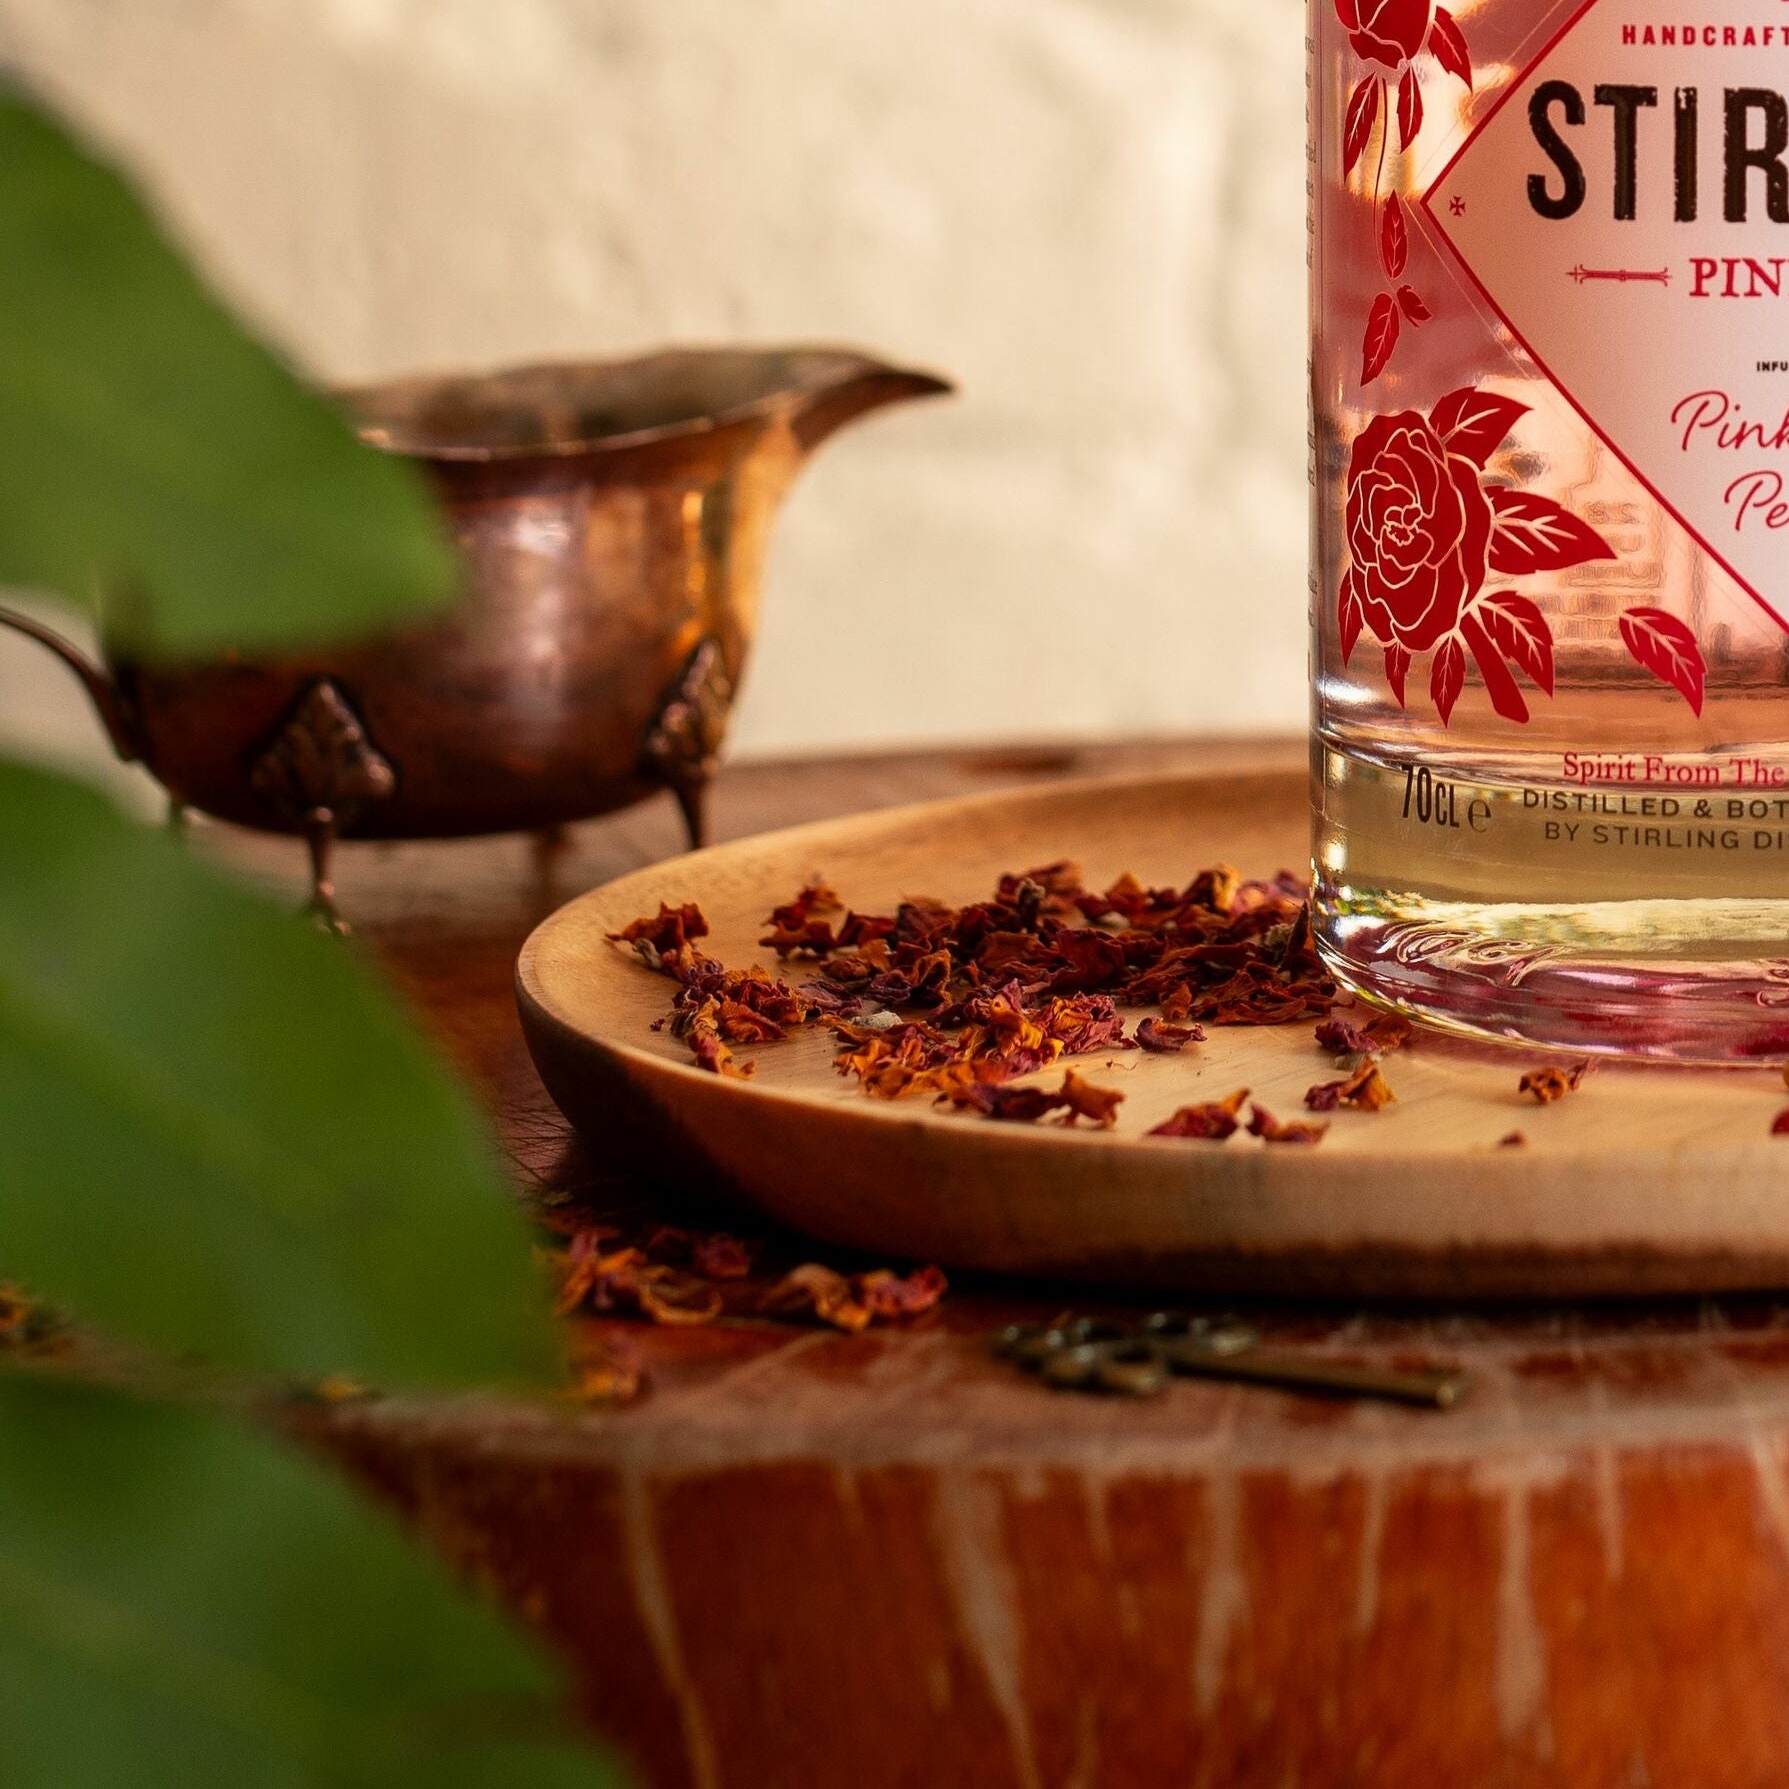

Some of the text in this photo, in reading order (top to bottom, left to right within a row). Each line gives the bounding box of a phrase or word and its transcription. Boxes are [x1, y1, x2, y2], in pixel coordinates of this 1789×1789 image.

[1563, 751, 1636, 785] Spirit
[1643, 756, 1720, 784] From
[1729, 758, 1783, 786] The
[1401, 764, 1460, 828] 70CL
[1523, 789, 1680, 817] DISTILLED
[1693, 797, 1714, 818] &
[1545, 822, 1580, 842] BY
[1593, 825, 1739, 850] STIRLING
